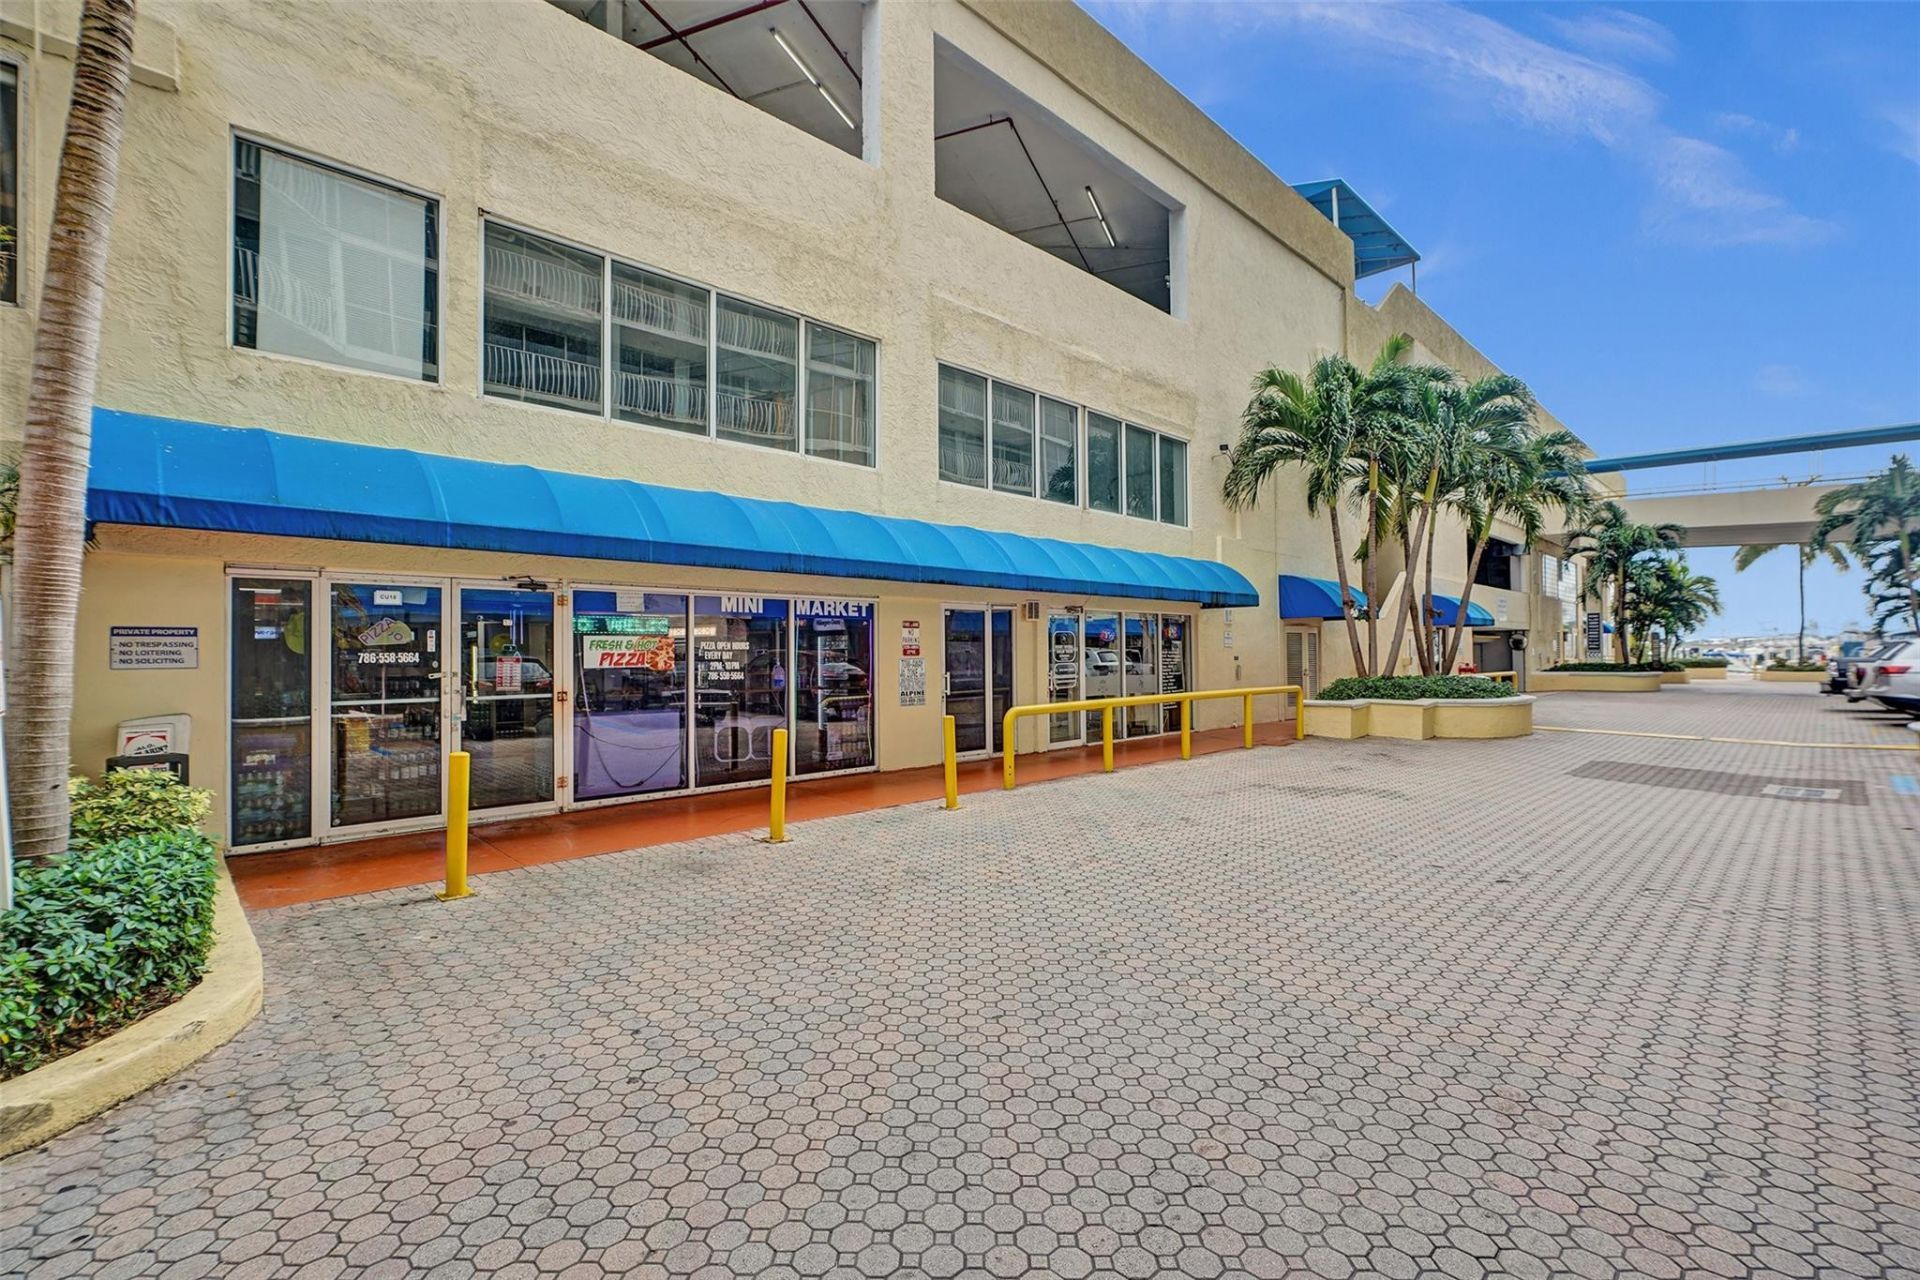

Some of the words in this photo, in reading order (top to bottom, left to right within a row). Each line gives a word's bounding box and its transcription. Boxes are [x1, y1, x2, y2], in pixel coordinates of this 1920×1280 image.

[720, 596, 764, 614] MINI
[796, 600, 870, 617] MARKET
[360, 618, 394, 644] PIZZA
[588, 639, 624, 650] FRESH
[624, 639, 634, 650] &
[636, 639, 658, 650] HOT
[700, 641, 716, 650] PIZZA
[716, 641, 731, 650] OPEN
[732, 641, 750, 650] HOURS
[357, 652, 420, 664] 786-558-5664
[598, 651, 647, 667] PIZZA
[704, 651, 721, 660] EVERY
[722, 651, 733, 660] DAY
